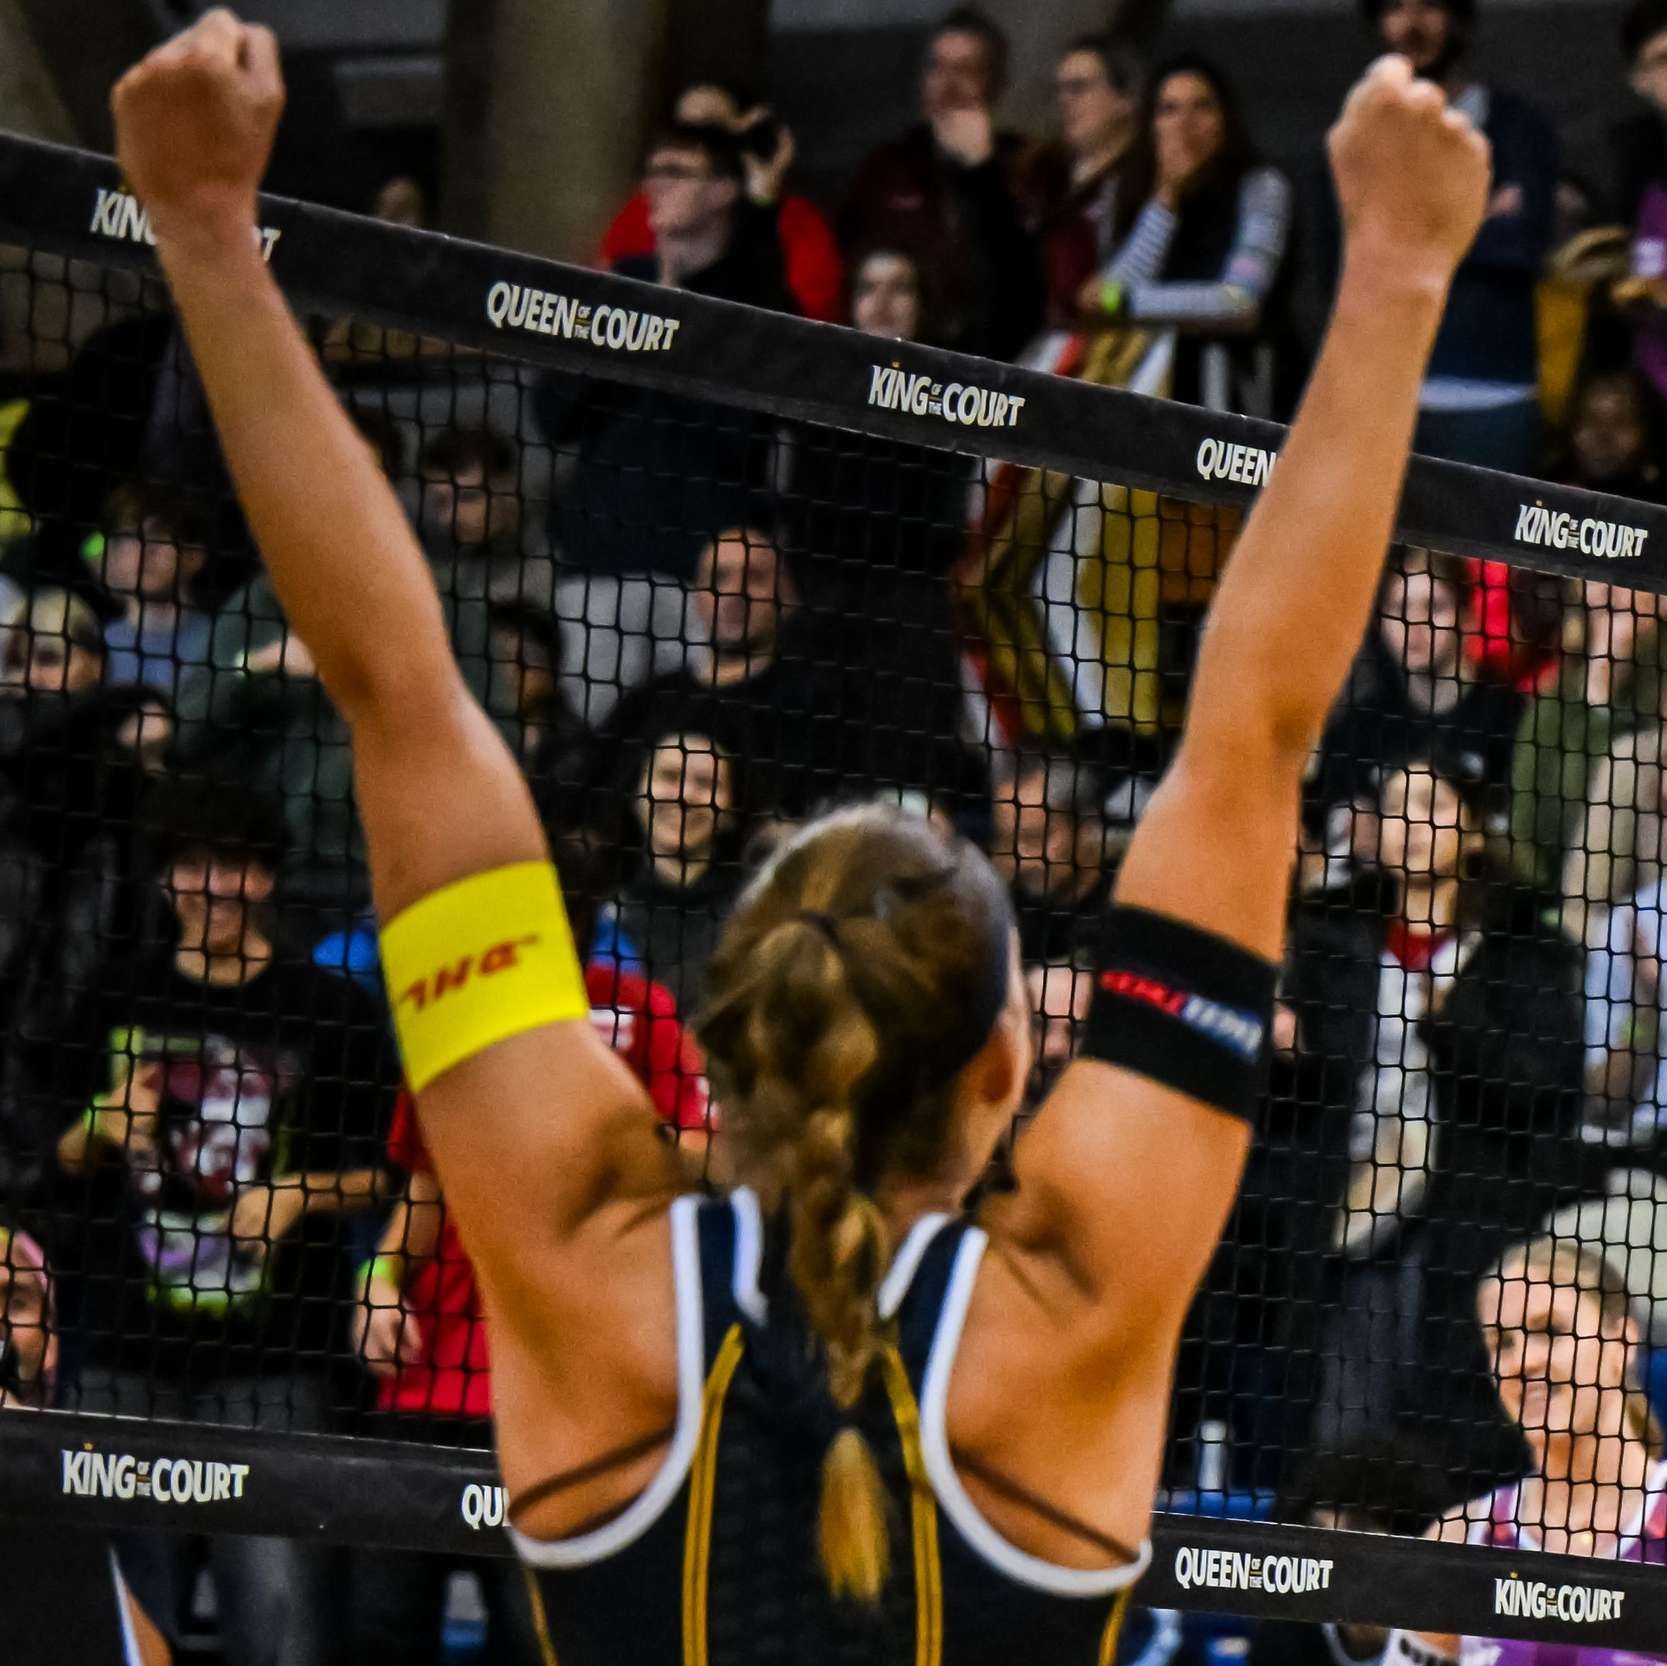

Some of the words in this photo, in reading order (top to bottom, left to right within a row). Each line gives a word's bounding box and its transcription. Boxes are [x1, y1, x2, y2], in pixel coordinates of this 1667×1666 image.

[487, 281, 579, 338] QUEEN
[591, 304, 680, 350] COURT
[868, 364, 932, 415] KING
[943, 383, 1026, 427] COURT
[1514, 504, 1570, 549] KING
[1579, 518, 1648, 558] COURT
[61, 1449, 136, 1500] KING
[151, 1457, 250, 1503] COURT
[1175, 1546, 1251, 1590] QUEEN
[1262, 1554, 1334, 1594] COURT
[1494, 1578, 1546, 1619] KING
[1557, 1584, 1625, 1622] COURT
